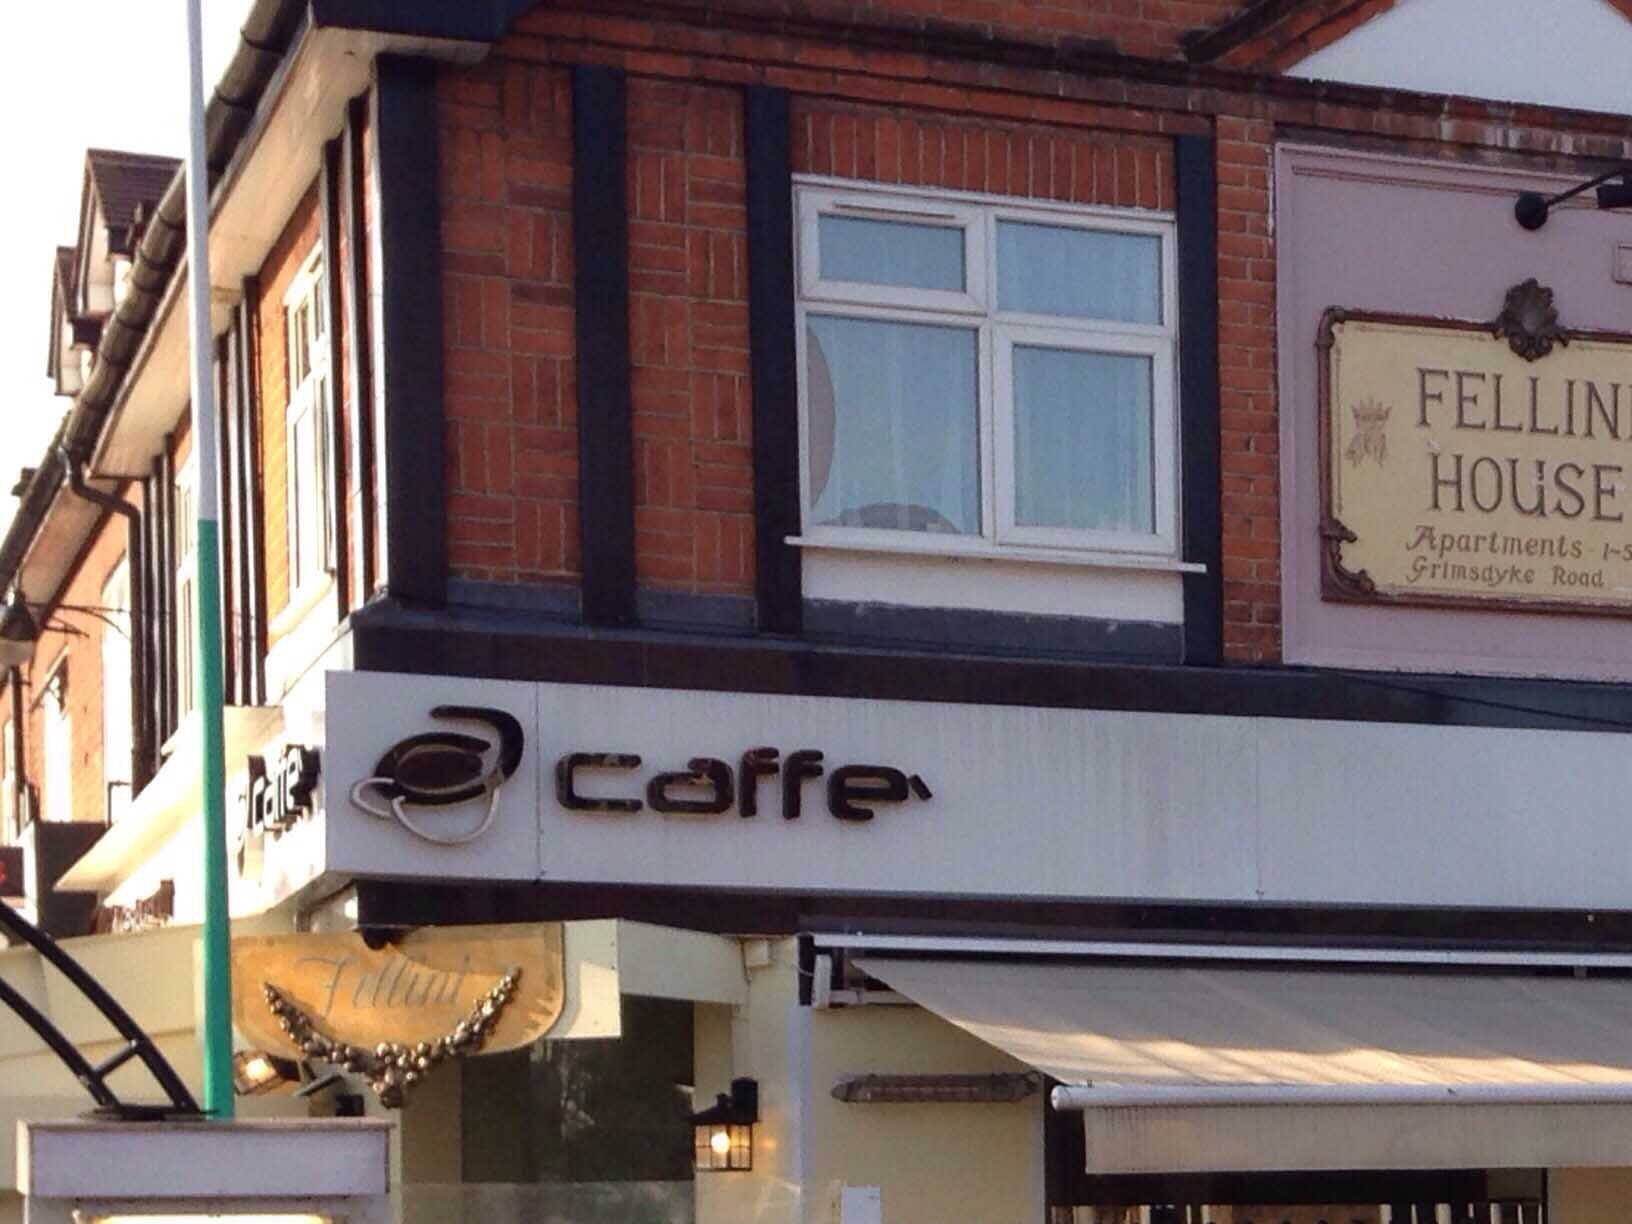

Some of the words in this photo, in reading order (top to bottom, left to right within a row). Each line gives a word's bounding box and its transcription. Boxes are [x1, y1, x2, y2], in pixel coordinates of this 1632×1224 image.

[1427, 454, 1624, 523] HOUSE
[1406, 525, 1583, 559] Apartments
[1406, 556, 1536, 587] Grimsdyke
[1552, 566, 1604, 587] Road
[298, 955, 471, 1019] Fellini
